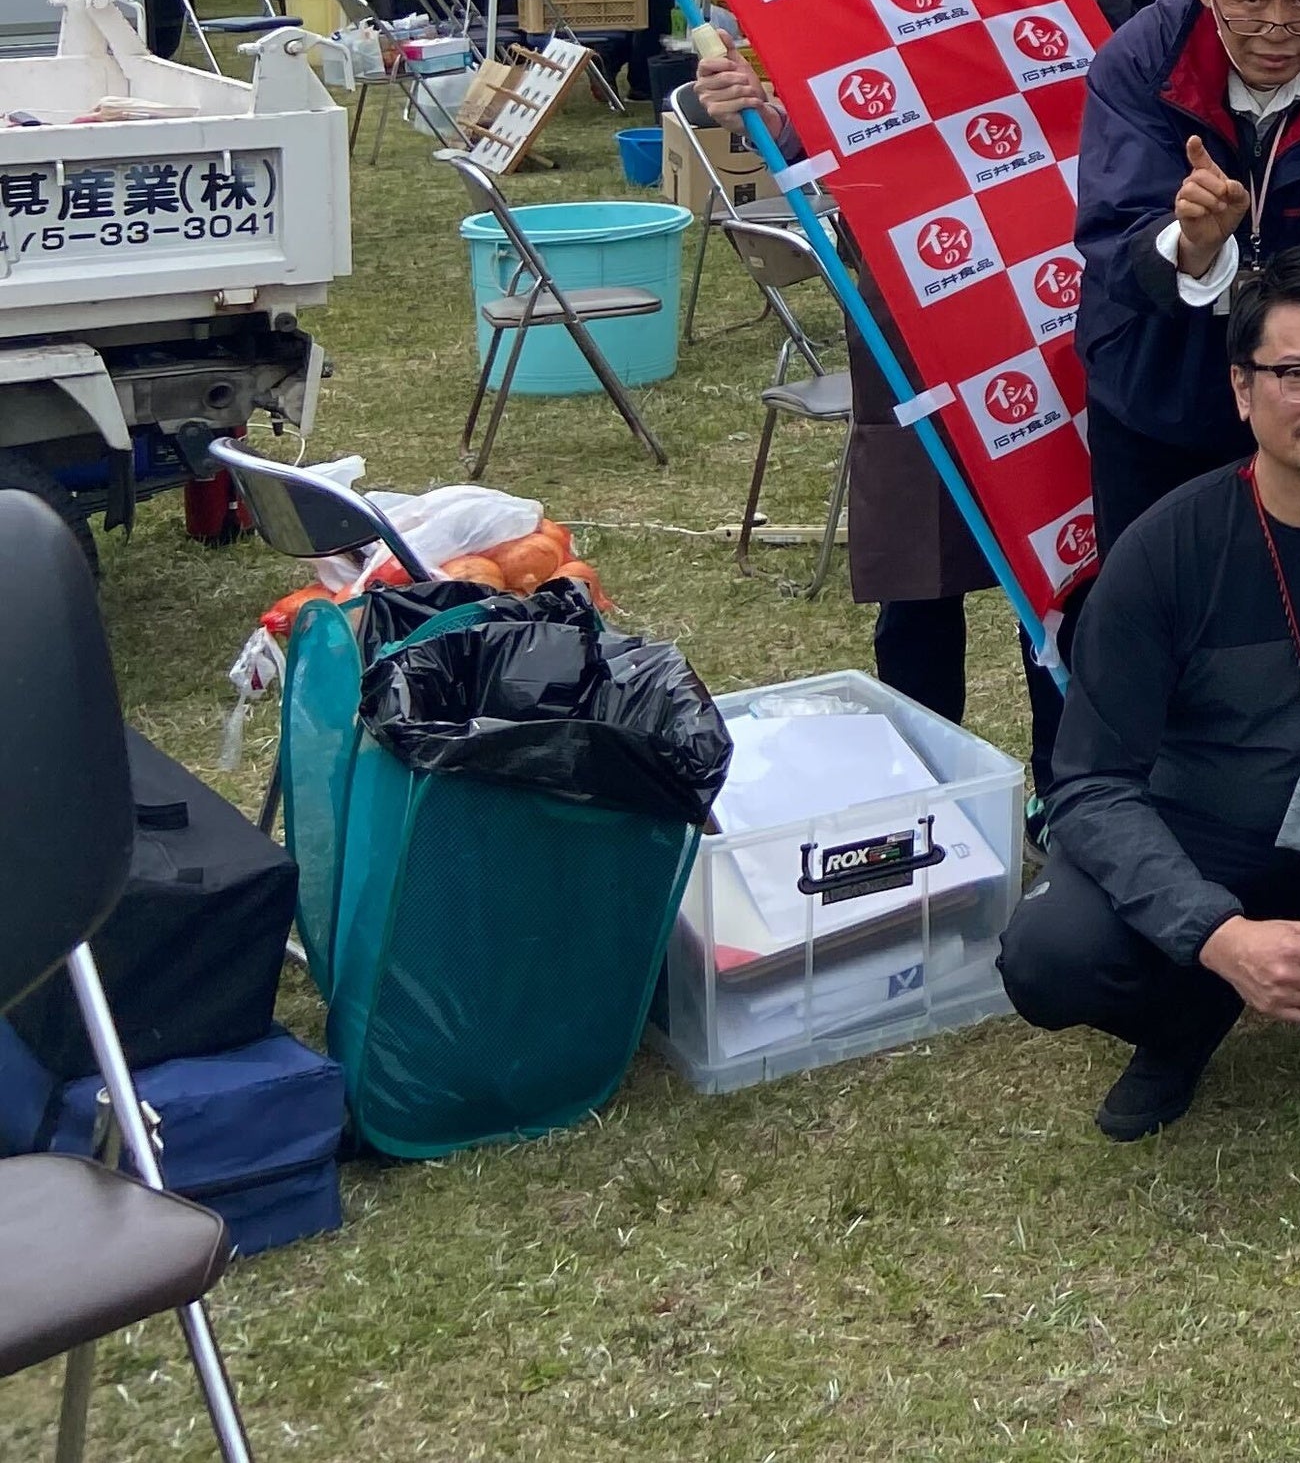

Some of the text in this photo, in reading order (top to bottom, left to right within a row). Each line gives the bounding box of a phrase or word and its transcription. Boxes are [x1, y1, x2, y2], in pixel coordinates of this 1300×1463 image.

[897, 6, 969, 35] 石井食品
[847, 110, 920, 144] 石井食品
[976, 150, 1045, 182] 石井食品
[924, 257, 995, 295] 石井食品
[994, 409, 1062, 449] 石井食品
[826, 847, 870, 873] ROX
